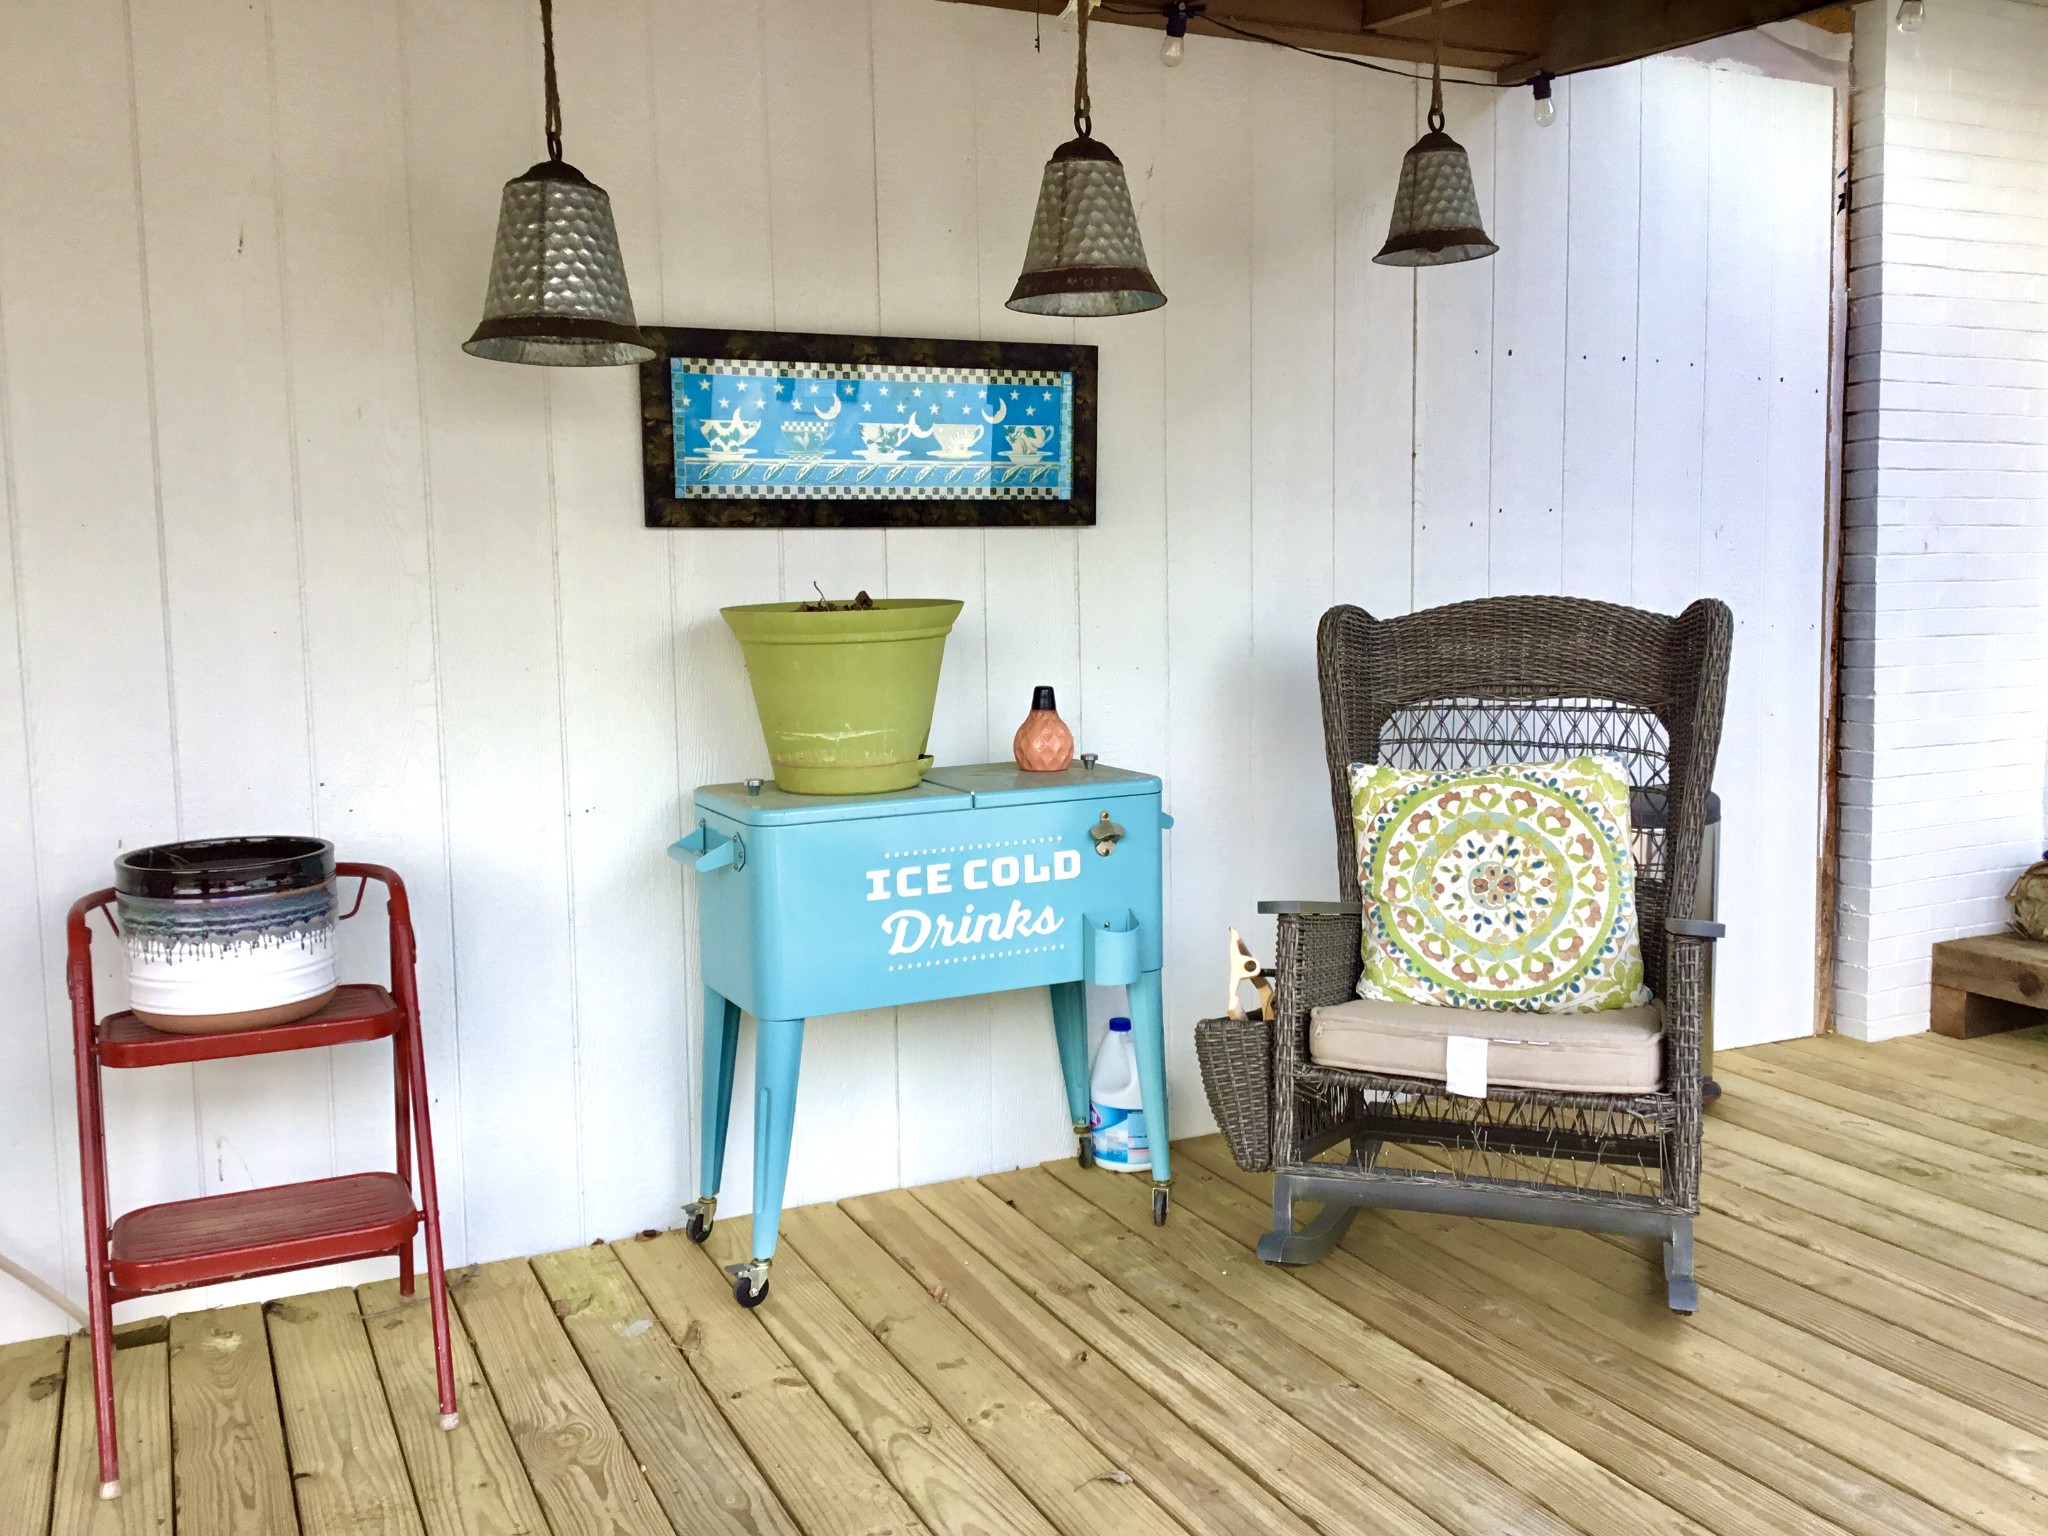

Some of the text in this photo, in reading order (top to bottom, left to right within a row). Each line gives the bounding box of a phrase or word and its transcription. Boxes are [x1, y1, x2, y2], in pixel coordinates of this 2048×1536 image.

[866, 849, 1081, 901] ICE COLD
[881, 899, 1065, 956] Drinks
